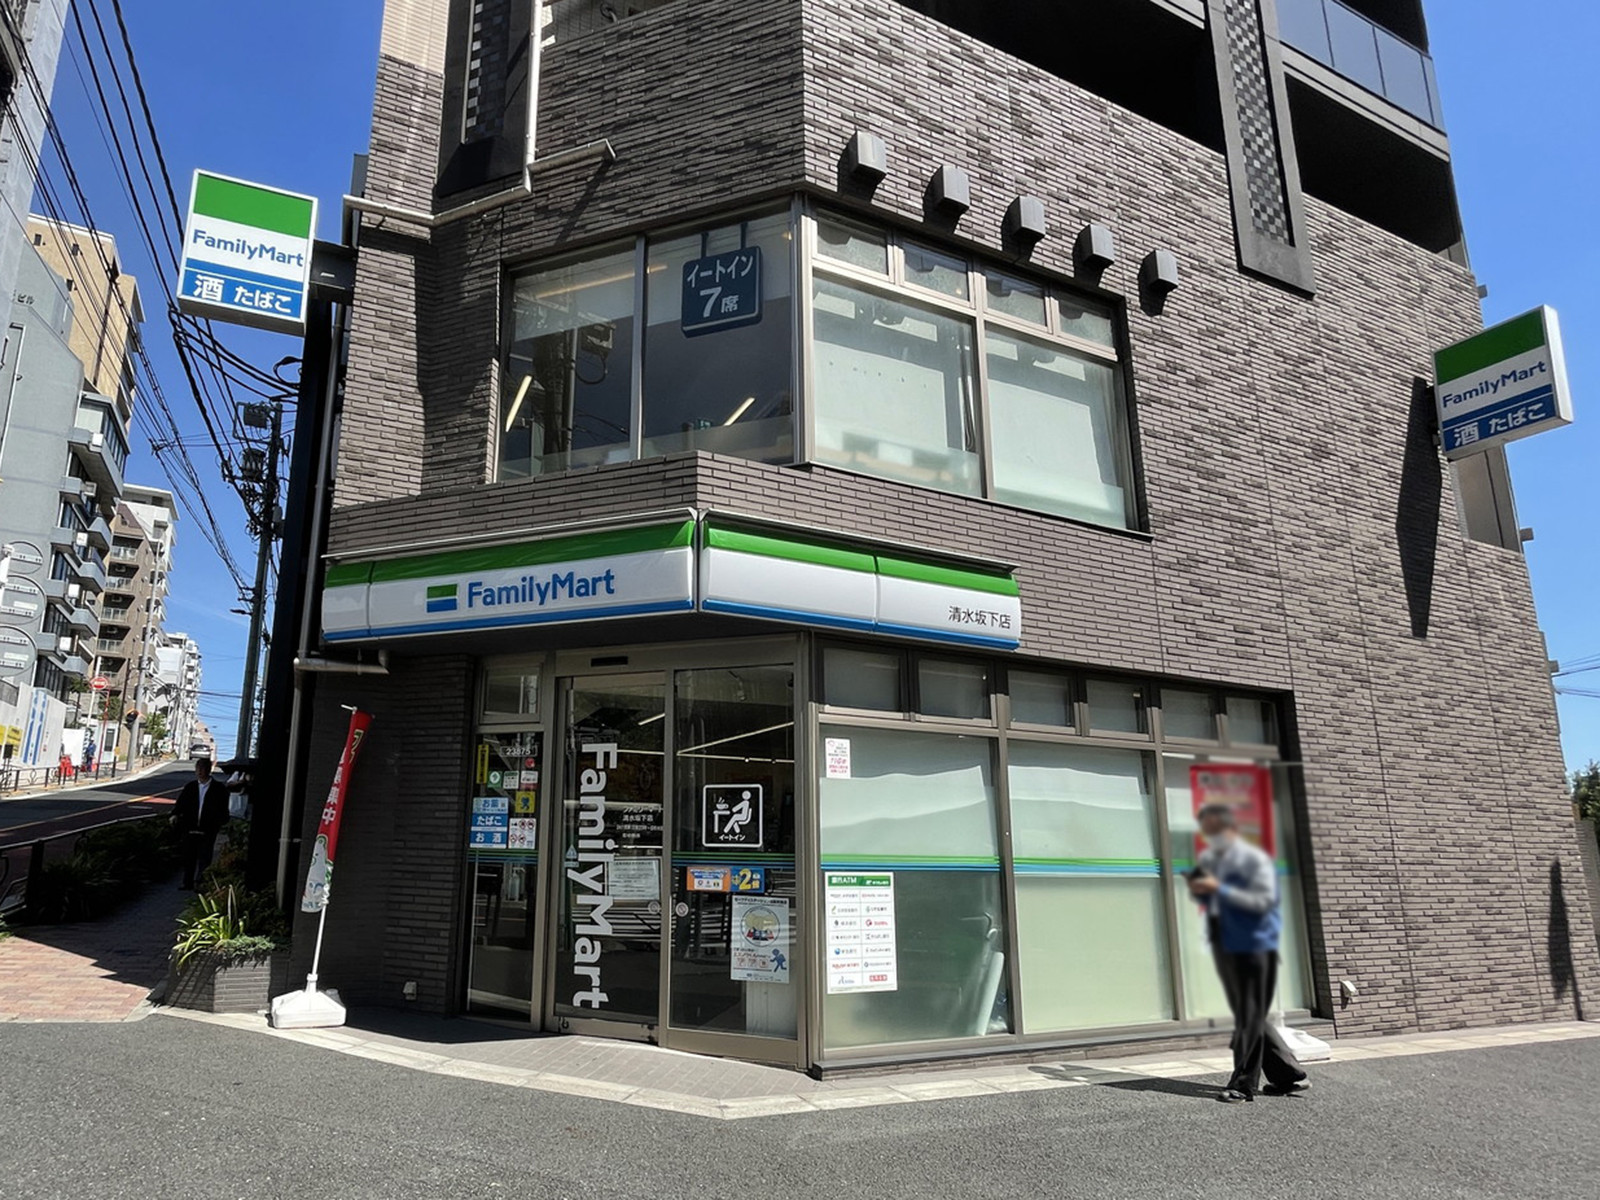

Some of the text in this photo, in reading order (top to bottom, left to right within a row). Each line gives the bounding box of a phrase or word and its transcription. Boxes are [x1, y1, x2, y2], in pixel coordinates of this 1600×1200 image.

[193, 229, 304, 267] FamilyMart
[687, 256, 754, 288] イートイン
[193, 275, 291, 313] 酒 たばこ
[700, 286, 739, 318] 7席
[1442, 361, 1546, 408] FamilyMart
[1454, 402, 1546, 447] 酒 たばこ
[468, 569, 615, 608] FamilyMart
[948, 605, 1012, 629] 清水坂下店
[475, 832, 502, 843] お酒
[477, 815, 502, 826] たばこ
[718, 834, 746, 842] イートイン
[566, 743, 618, 1009] FamilyMart
